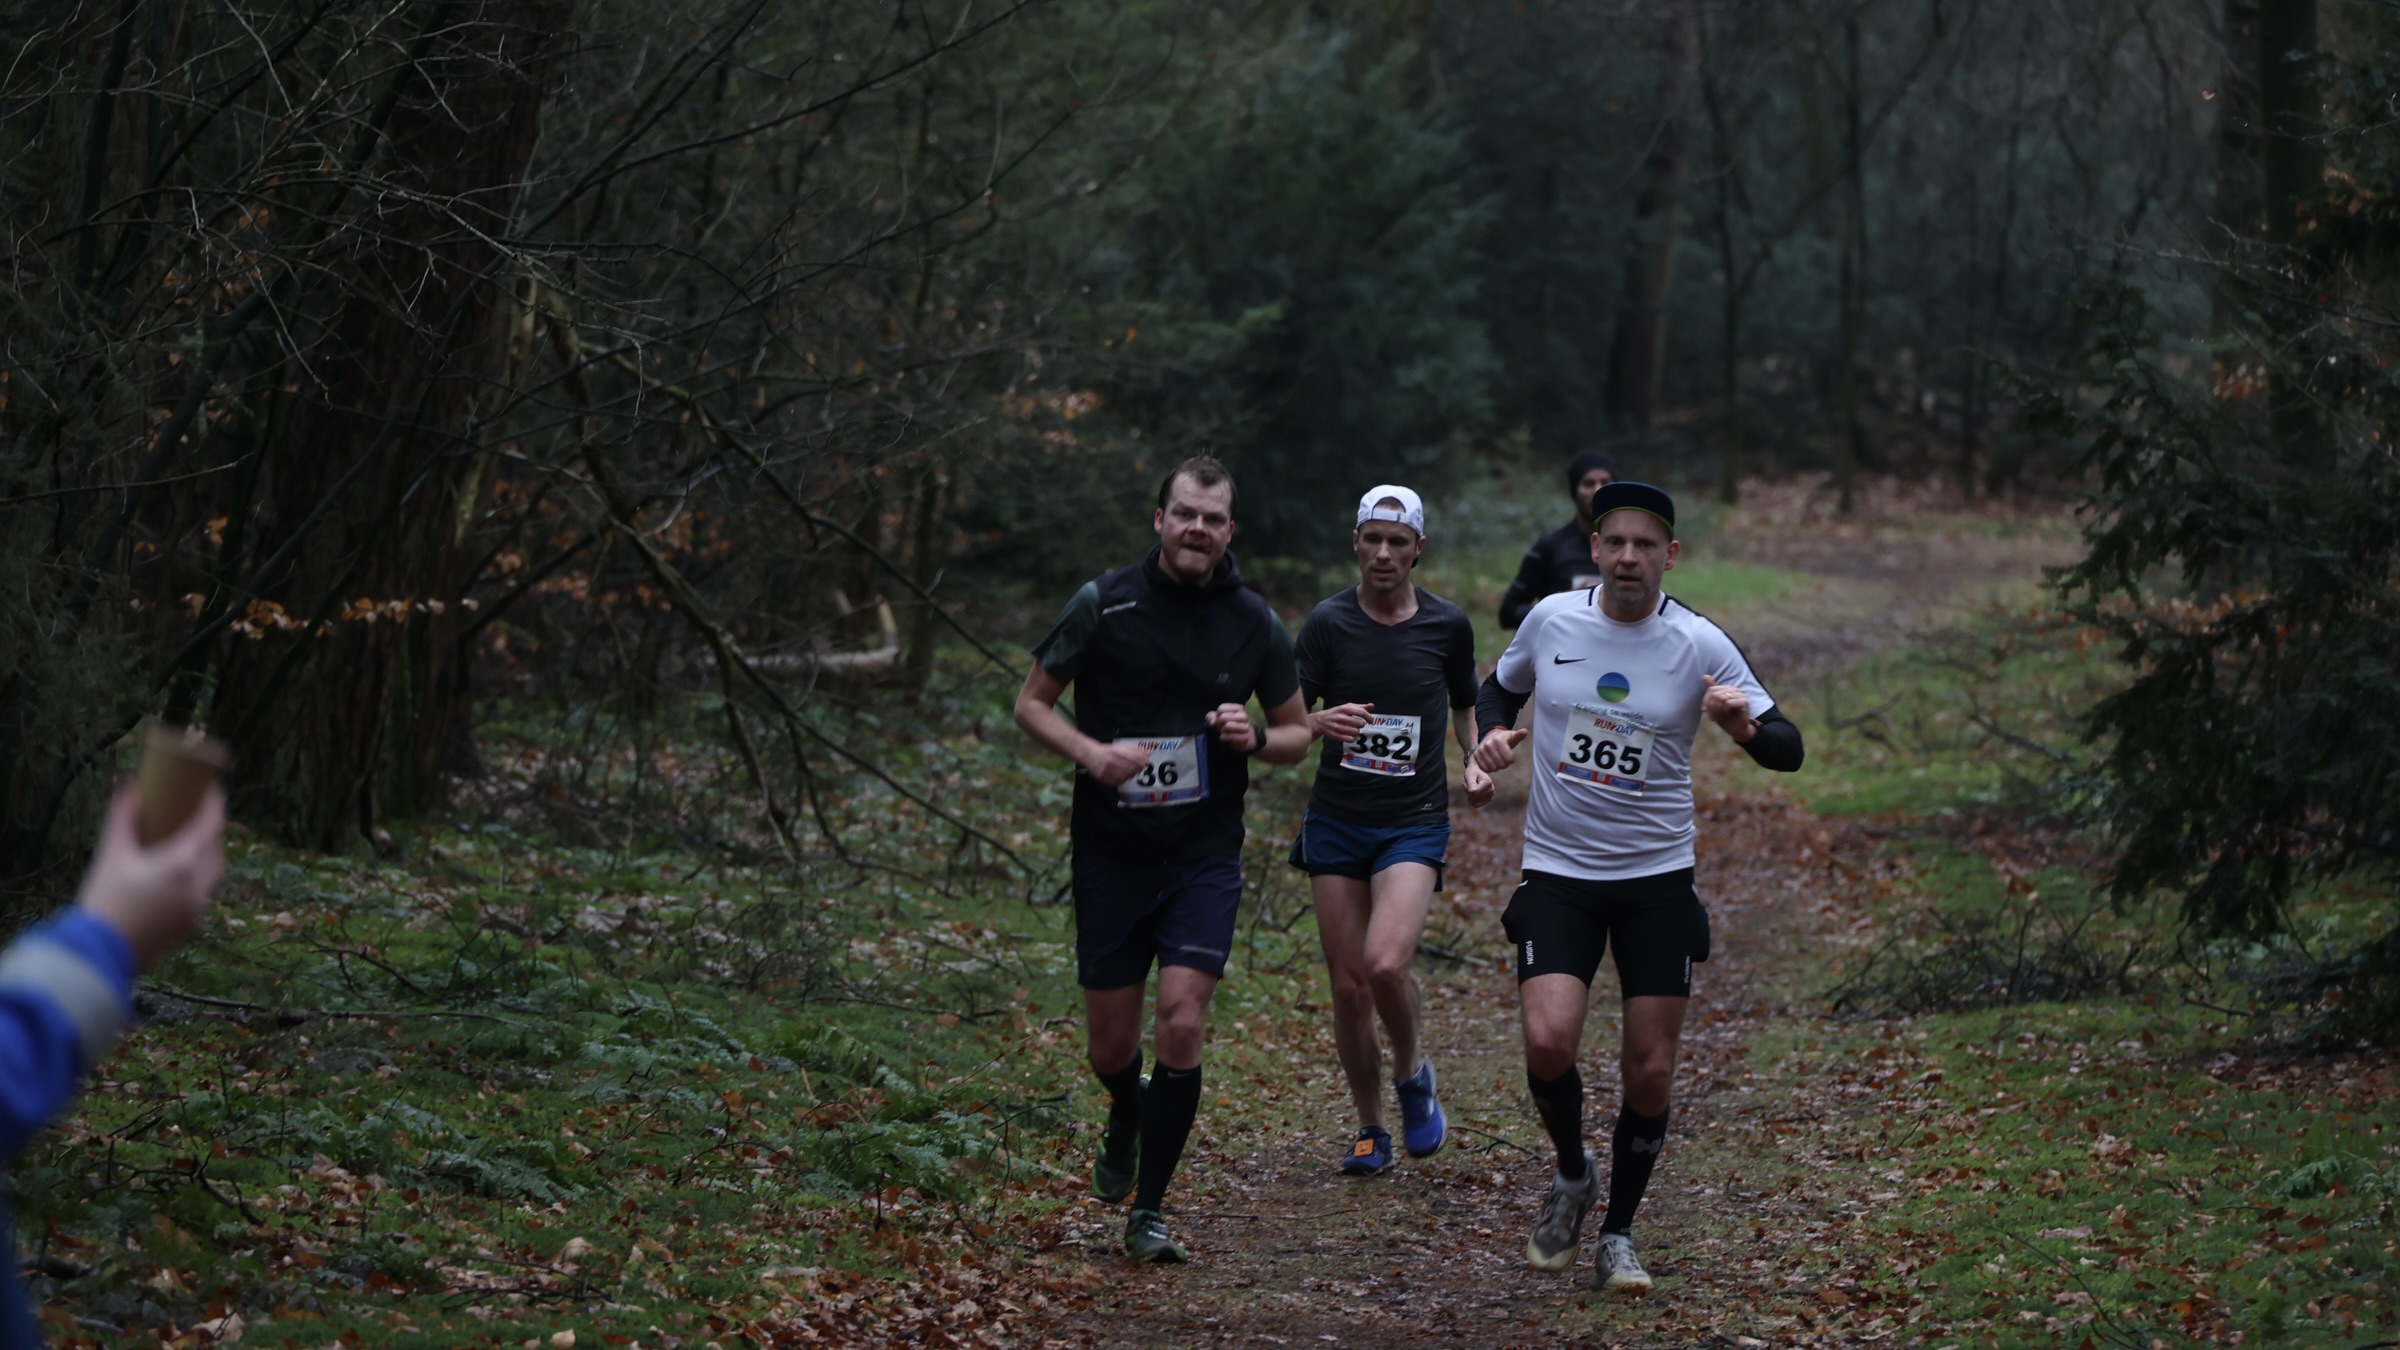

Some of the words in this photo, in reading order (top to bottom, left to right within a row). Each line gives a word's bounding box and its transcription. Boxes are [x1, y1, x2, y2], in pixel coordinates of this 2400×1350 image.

[1349, 733, 1412, 761] 382
[1569, 734, 1643, 775] 365
[1137, 761, 1178, 787] 36
